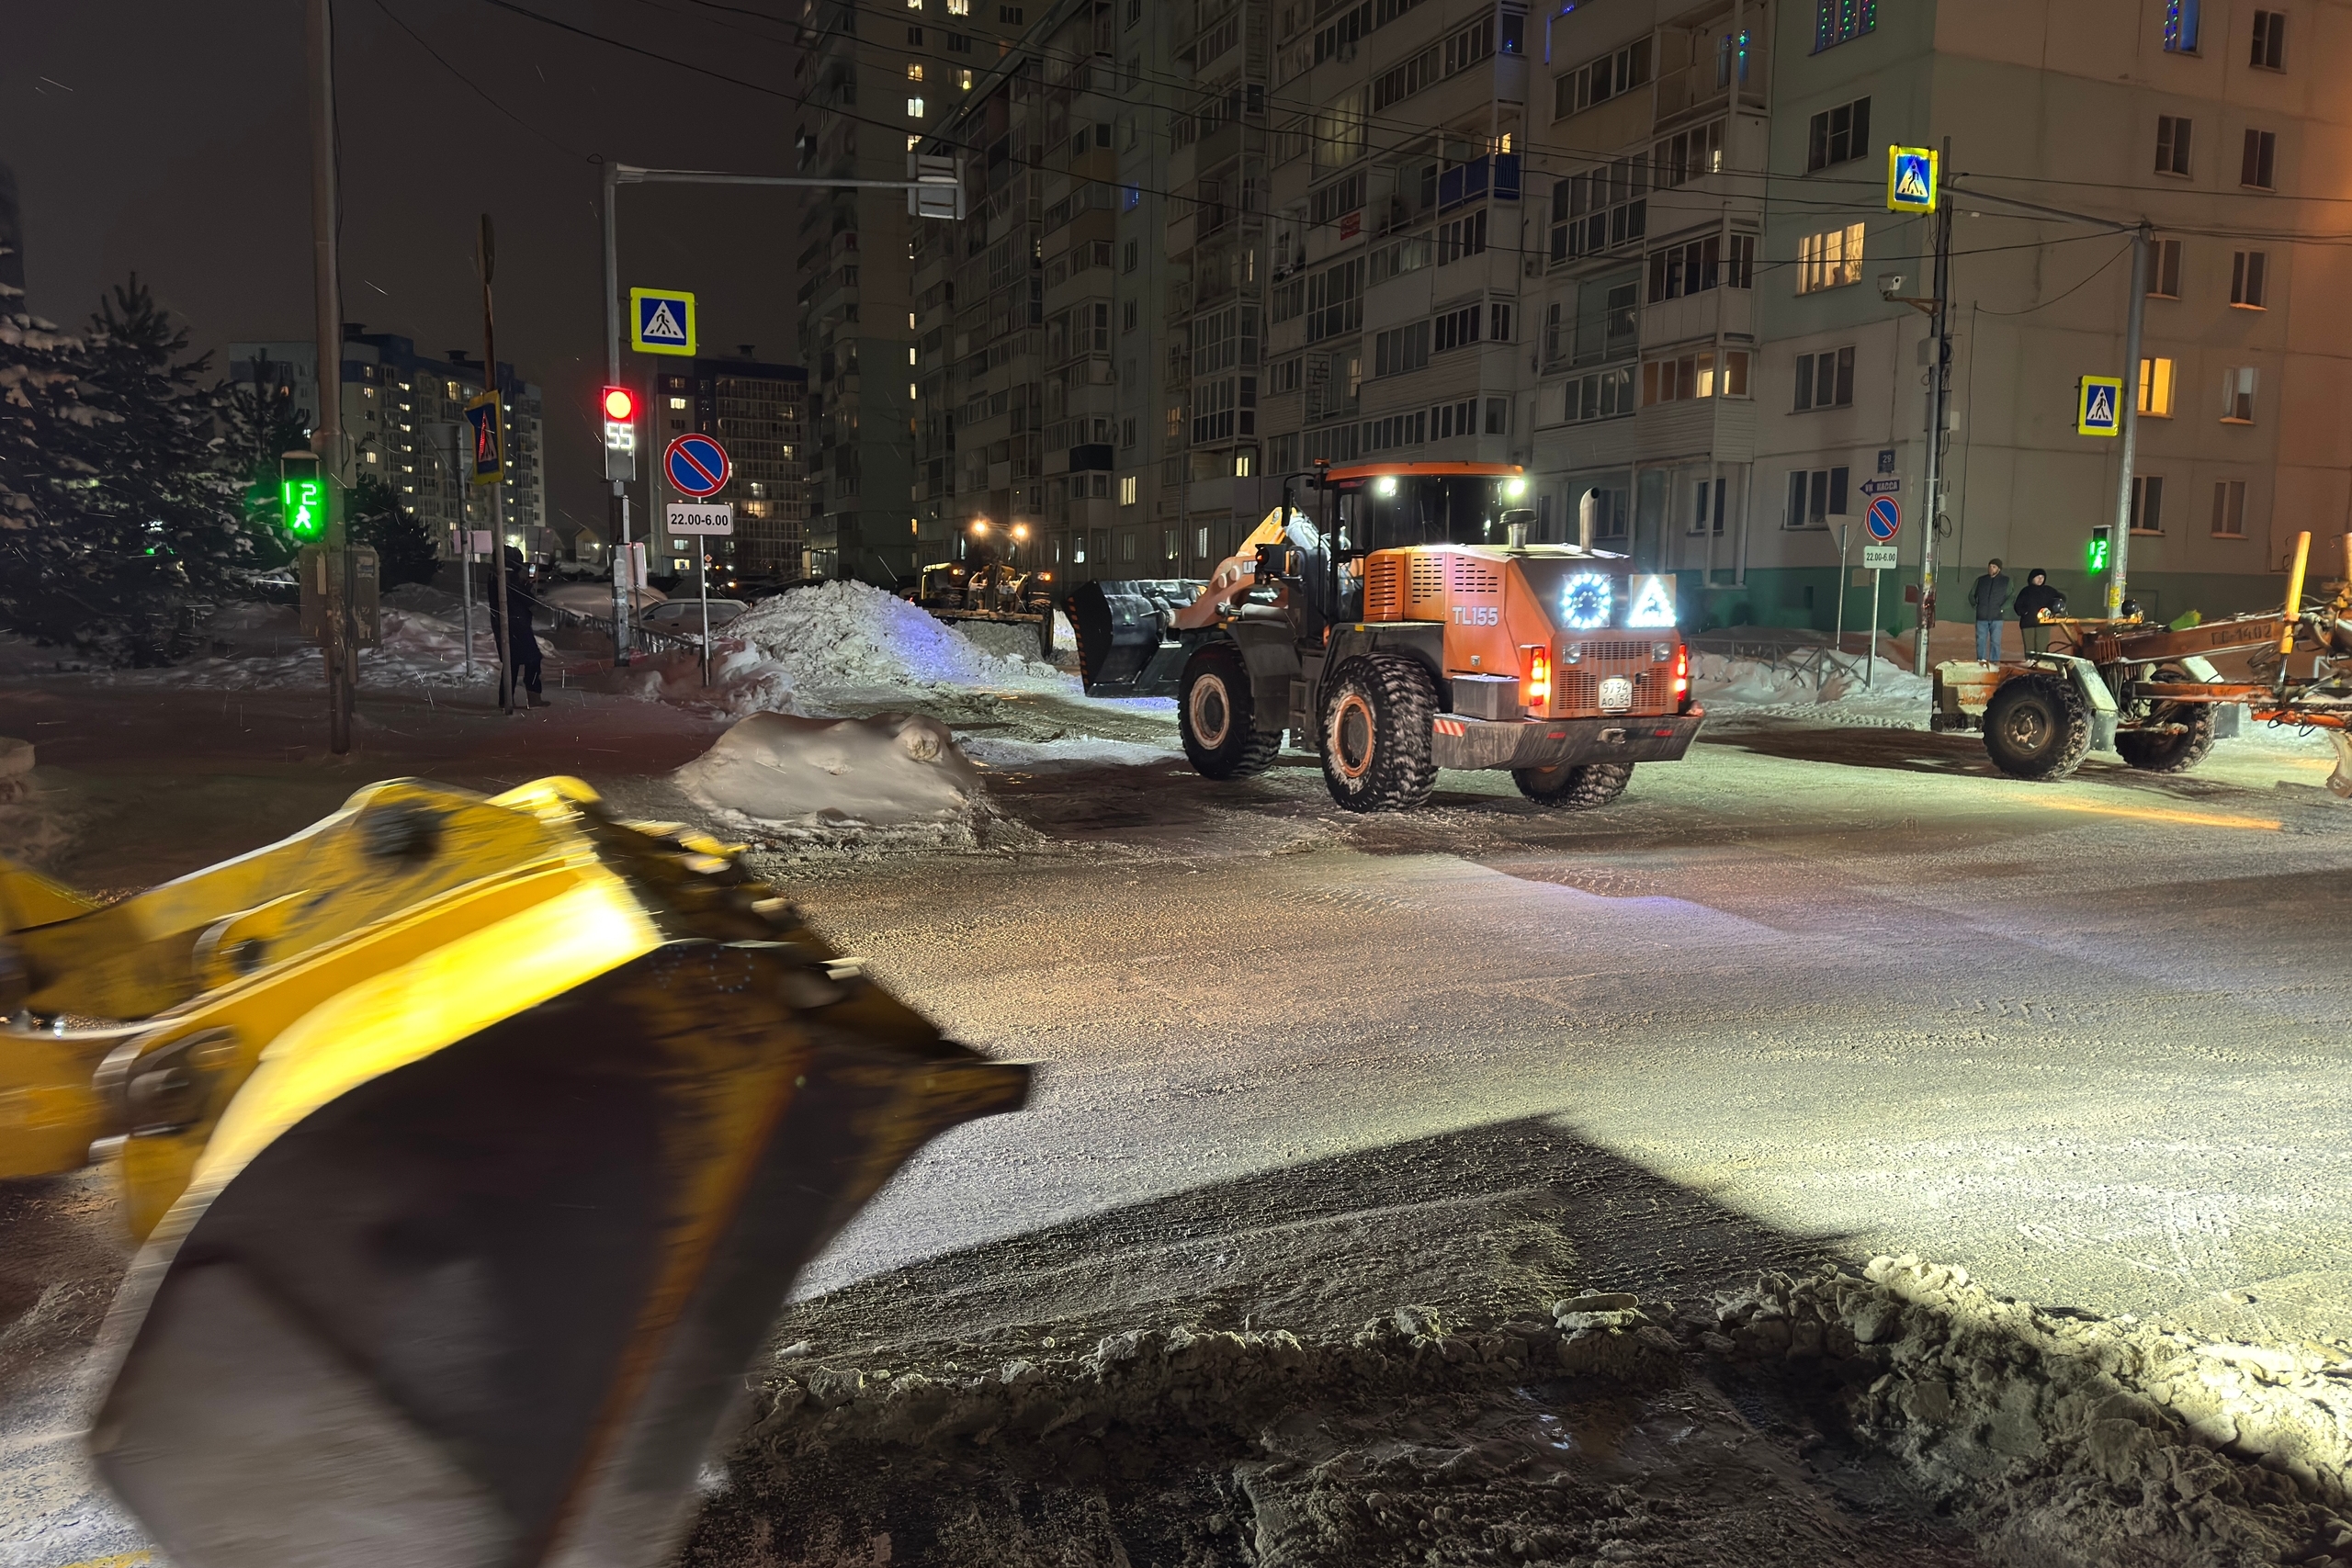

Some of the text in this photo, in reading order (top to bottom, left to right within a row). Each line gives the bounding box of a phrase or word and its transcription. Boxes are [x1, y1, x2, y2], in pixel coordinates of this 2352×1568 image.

[606, 423, 634, 449] 55
[285, 482, 317, 505] 12
[671, 513, 729, 526] 22.00-6.00
[2089, 540, 2107, 556] 12
[1866, 552, 1896, 561] 22.00-6.00
[1452, 606, 1498, 626] TL155
[1602, 682, 1628, 694] 9794
